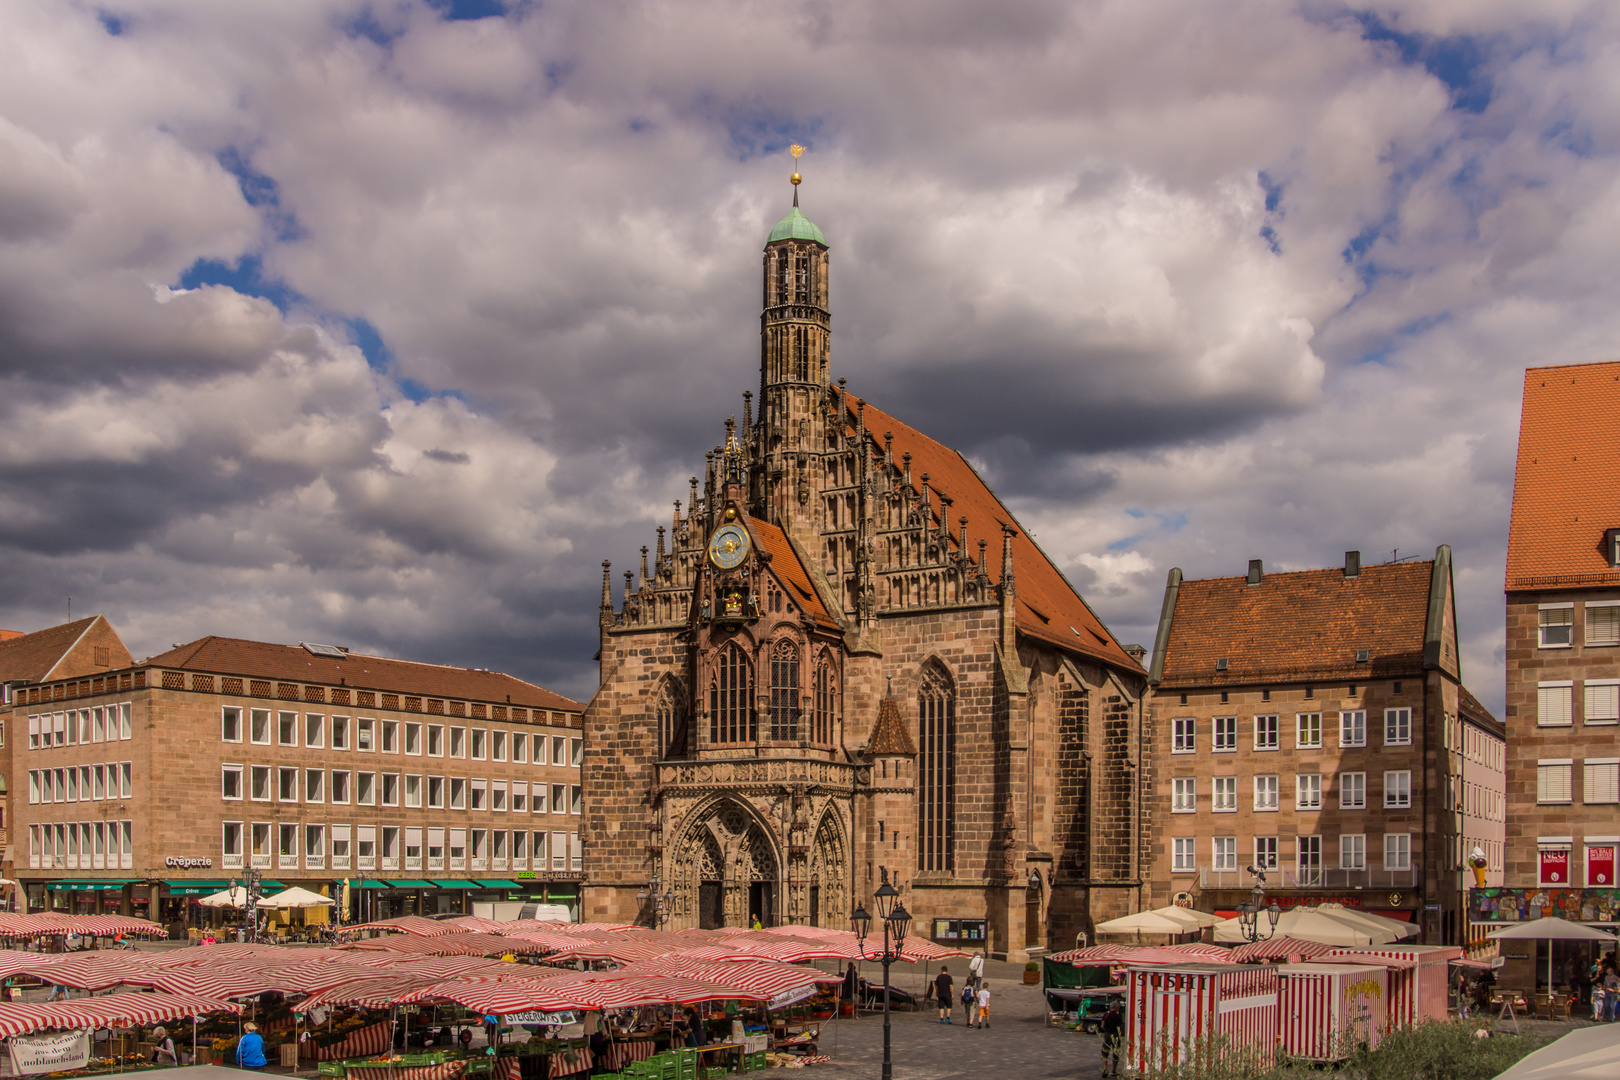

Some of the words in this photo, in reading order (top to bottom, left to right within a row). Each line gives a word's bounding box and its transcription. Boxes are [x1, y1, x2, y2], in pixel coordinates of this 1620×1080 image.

[1543, 851, 1566, 859] NEU
[165, 856, 212, 868] Crêperie
[517, 871, 537, 879] GEERS
[1265, 896, 1310, 907] BLOCK
[1137, 973, 1208, 991] SUSHI
[1137, 998, 1147, 1025] 김밥
[52, 1046, 71, 1054] dem
[21, 1052, 84, 1067] noblauchsland
